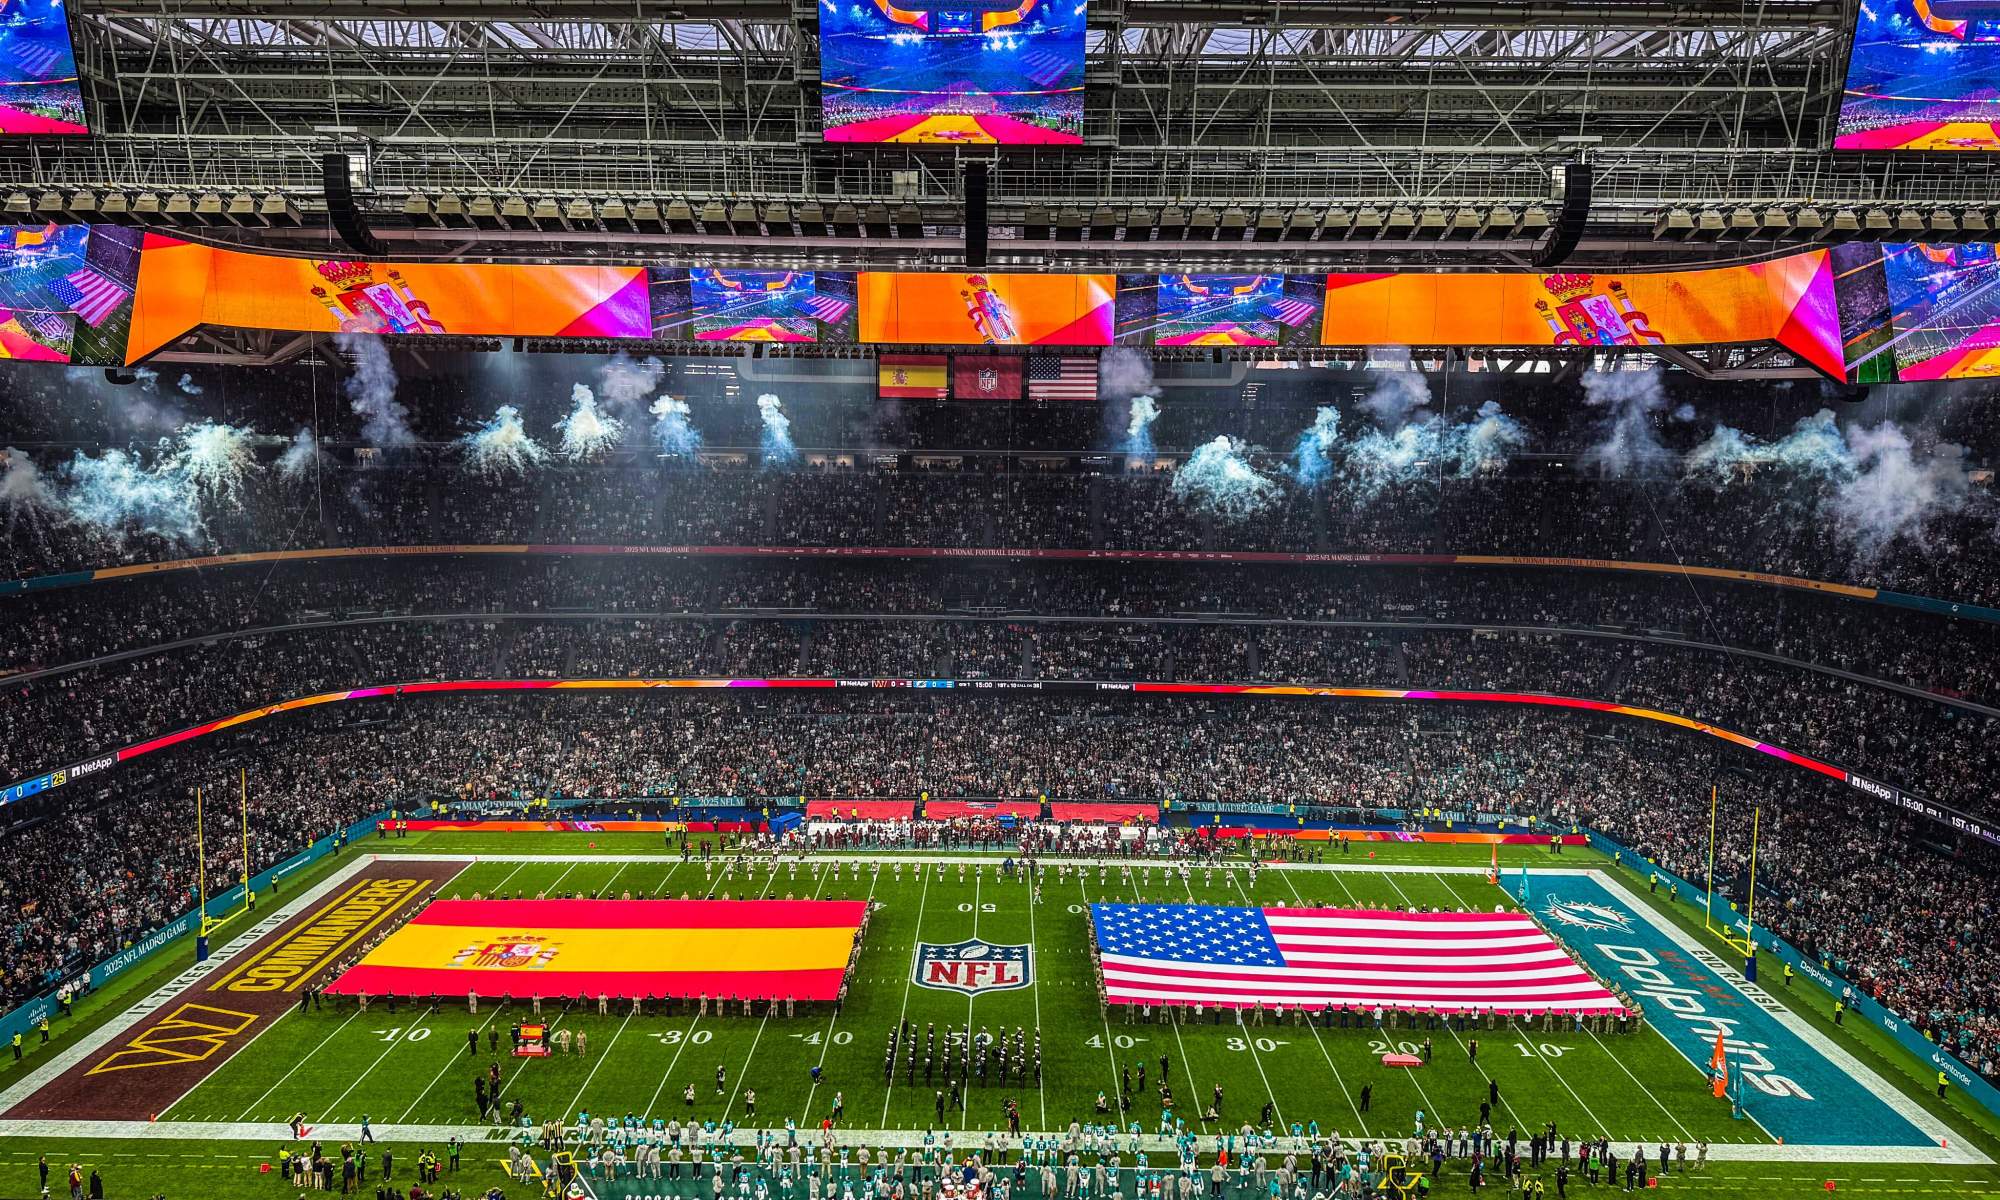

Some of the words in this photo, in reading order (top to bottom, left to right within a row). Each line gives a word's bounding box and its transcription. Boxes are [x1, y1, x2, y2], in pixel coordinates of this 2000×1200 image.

[982, 379, 996, 389] NFL
[1548, 558, 1582, 566] FOOTBALL
[81, 757, 113, 774] NetApp
[52, 773, 65, 785] 25
[16, 786, 23, 797] 0
[1860, 779, 1891, 800] NetApp
[700, 797, 718, 806] 2025
[720, 798, 737, 806] NFL
[1201, 803, 1218, 811] NFL
[1220, 804, 1250, 812] MADRID
[1251, 805, 1274, 813] GAME
[1902, 796, 1924, 813] 15:00
[1951, 816, 1966, 829] 1ST
[1970, 824, 1980, 835] 10
[1982, 829, 1996, 840] BALL
[228, 878, 418, 992] COMMANDERS
[104, 960, 123, 977] 2025
[123, 951, 138, 966] NFL
[138, 934, 166, 957] MADRID
[166, 920, 188, 939] GAME
[127, 1004, 152, 1016] IT
[151, 965, 214, 999] TAKES
[210, 947, 246, 962] ALL
[246, 928, 264, 940] OF
[268, 914, 290, 925] US
[927, 961, 1019, 988] NFL
[1691, 950, 1728, 972] END
[1724, 972, 1789, 1014] RACISM
[1800, 960, 1833, 988] Dolphins
[1595, 943, 1816, 1101] Dolphins
[1883, 1015, 1898, 1033] VISA
[380, 1028, 431, 1042] 10
[661, 1031, 712, 1045] 30
[803, 1032, 853, 1045] 40
[1085, 1035, 1134, 1049] 40
[1227, 1038, 1276, 1052] 30
[1368, 1041, 1419, 1055] 20
[1514, 1043, 1563, 1058] 10
[1939, 1057, 1972, 1087] Santander
